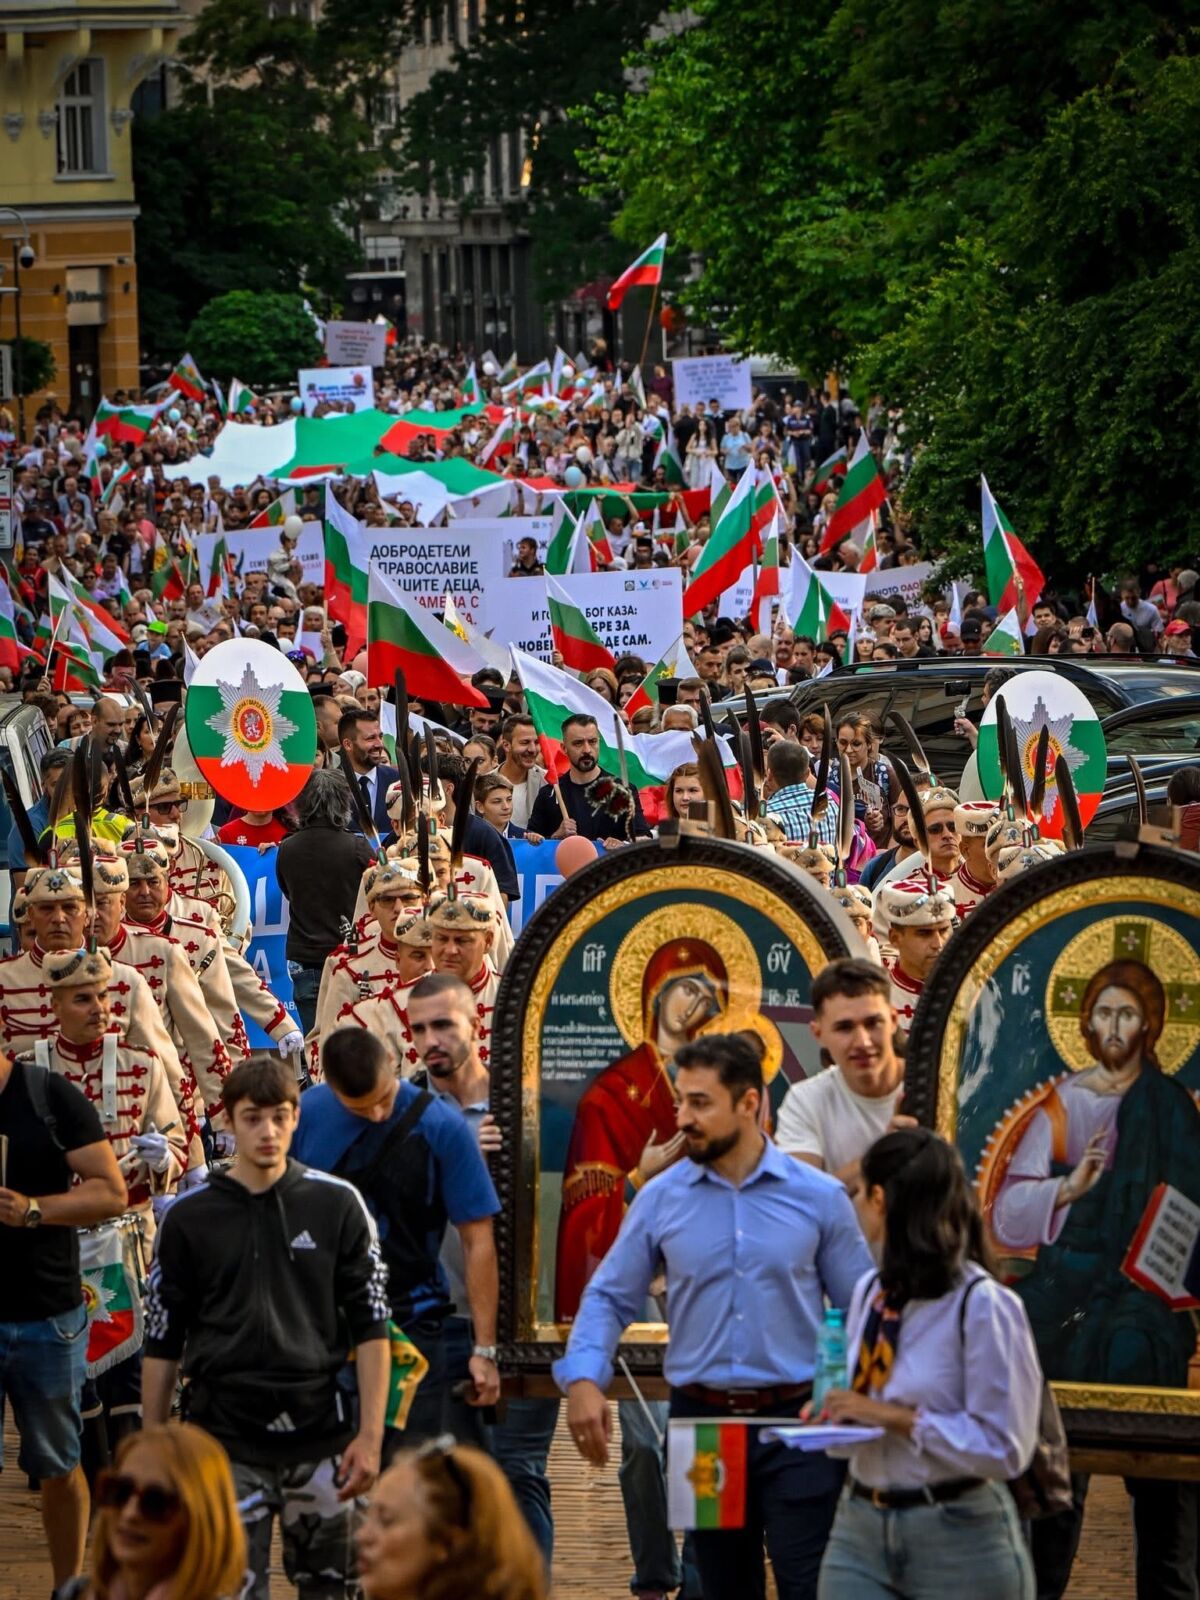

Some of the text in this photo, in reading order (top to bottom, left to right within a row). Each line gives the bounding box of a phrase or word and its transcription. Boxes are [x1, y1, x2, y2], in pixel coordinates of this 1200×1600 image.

[370, 545, 470, 560] ДОБРОДЕТЕЛИ
[378, 561, 479, 575] ПРАВОСЛАВИЕ
[393, 579, 484, 594] ШИТЕ ДЕЦА,
[414, 595, 480, 609] АМЕА С
[532, 611, 539, 621] И
[585, 604, 638, 618] БОГ КАЗА:
[591, 620, 631, 633] БРЕ ЗА
[622, 633, 652, 647] САМ.
